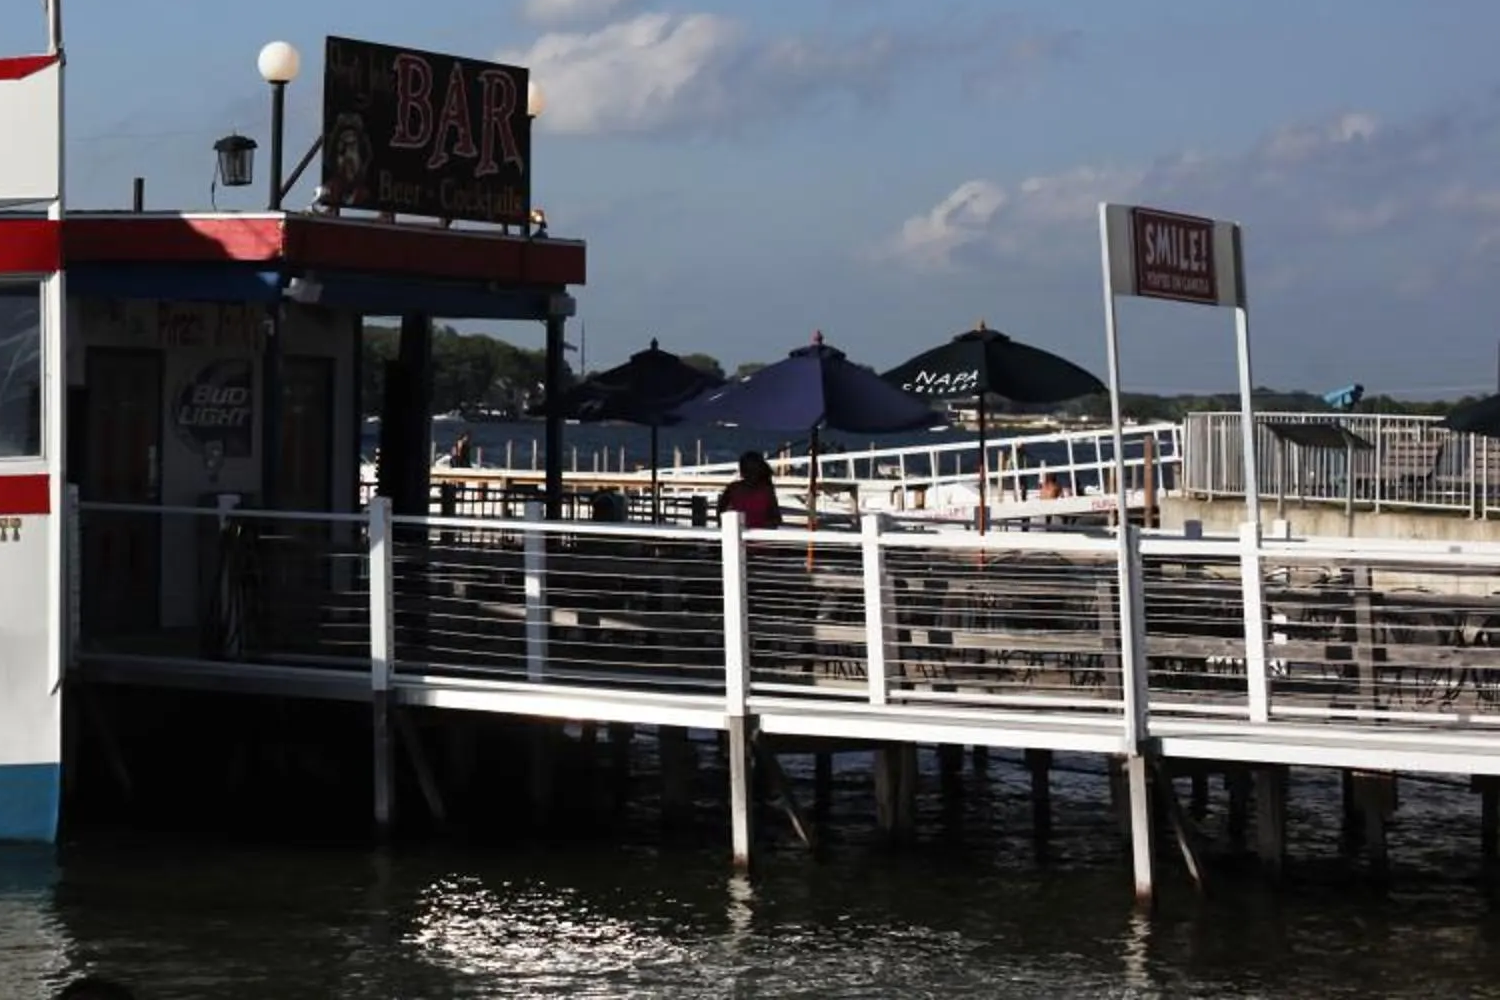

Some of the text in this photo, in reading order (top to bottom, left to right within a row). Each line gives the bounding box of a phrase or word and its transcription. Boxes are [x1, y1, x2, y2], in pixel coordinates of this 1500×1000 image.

[389, 53, 524, 179] BAR
[378, 168, 421, 206] Beer
[1145, 223, 1207, 273] SMILE!
[915, 369, 979, 385] NAPA
[192, 385, 249, 405] BUD
[178, 406, 250, 426] LIGHT
